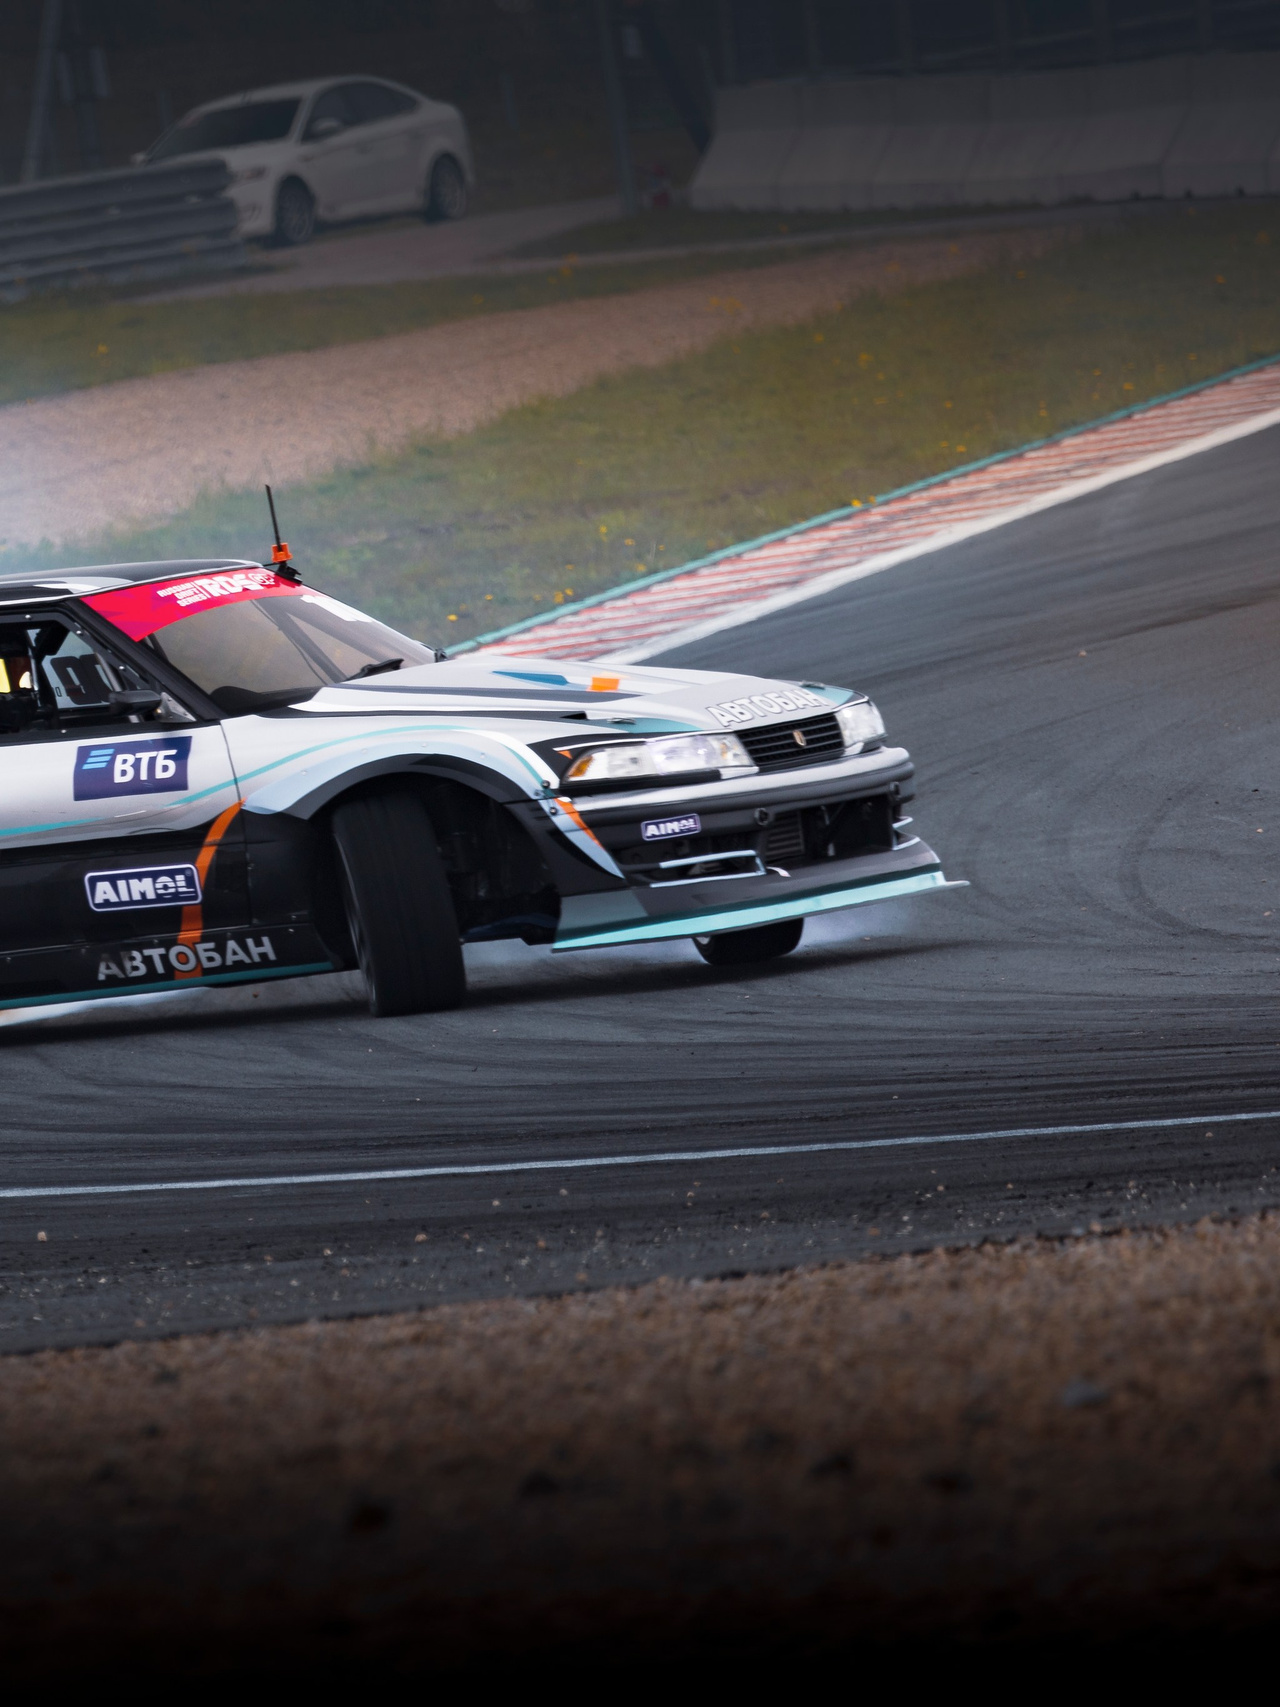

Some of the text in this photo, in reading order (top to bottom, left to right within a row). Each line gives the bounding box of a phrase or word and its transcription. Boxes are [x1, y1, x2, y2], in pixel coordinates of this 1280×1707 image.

[177, 593, 207, 607] SERIES
[705, 689, 829, 727] АВТОБАН
[114, 749, 178, 783] ВТБ
[94, 875, 195, 903] AIMOL
[97, 936, 277, 981] АВТОБАН
